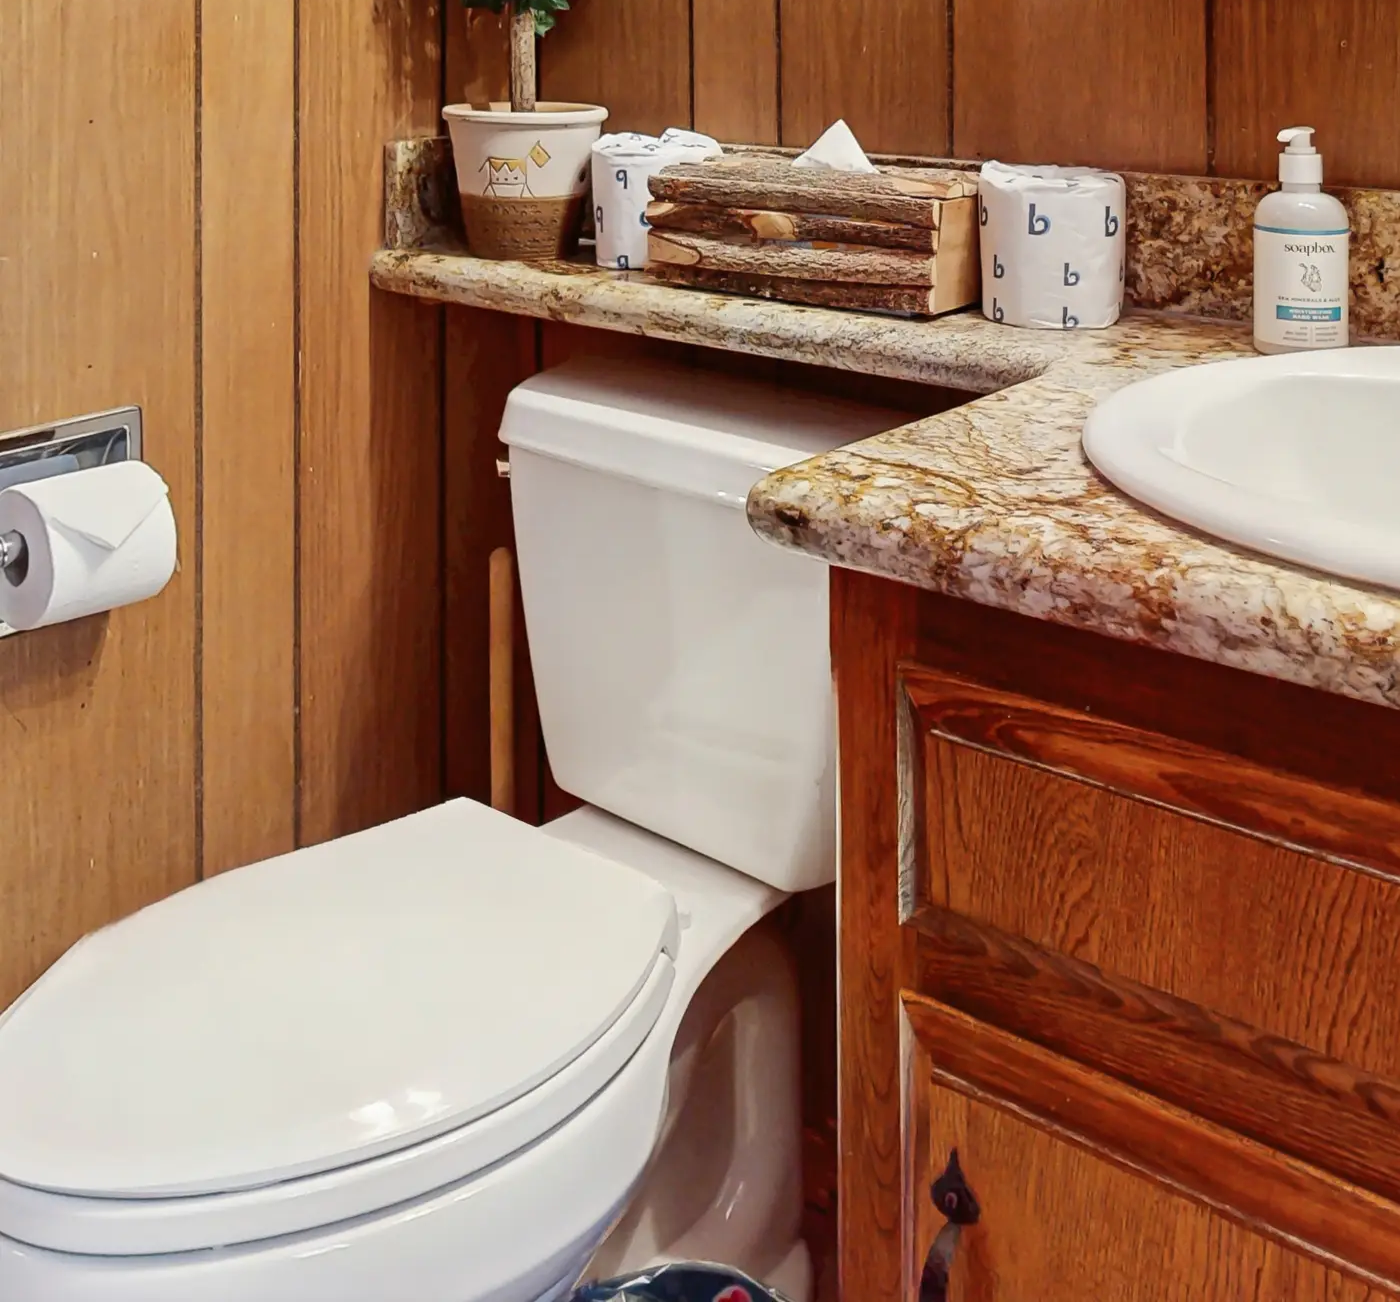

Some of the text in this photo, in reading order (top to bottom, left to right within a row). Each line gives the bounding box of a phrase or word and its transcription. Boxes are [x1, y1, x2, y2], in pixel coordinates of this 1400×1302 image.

[1028, 203, 1051, 235] b
[1105, 206, 1119, 237] b
[1284, 241, 1336, 257] soapbox
[993, 254, 1005, 279] b
[1063, 262, 1080, 286] b
[993, 298, 1004, 322] b
[1062, 306, 1080, 329] b
